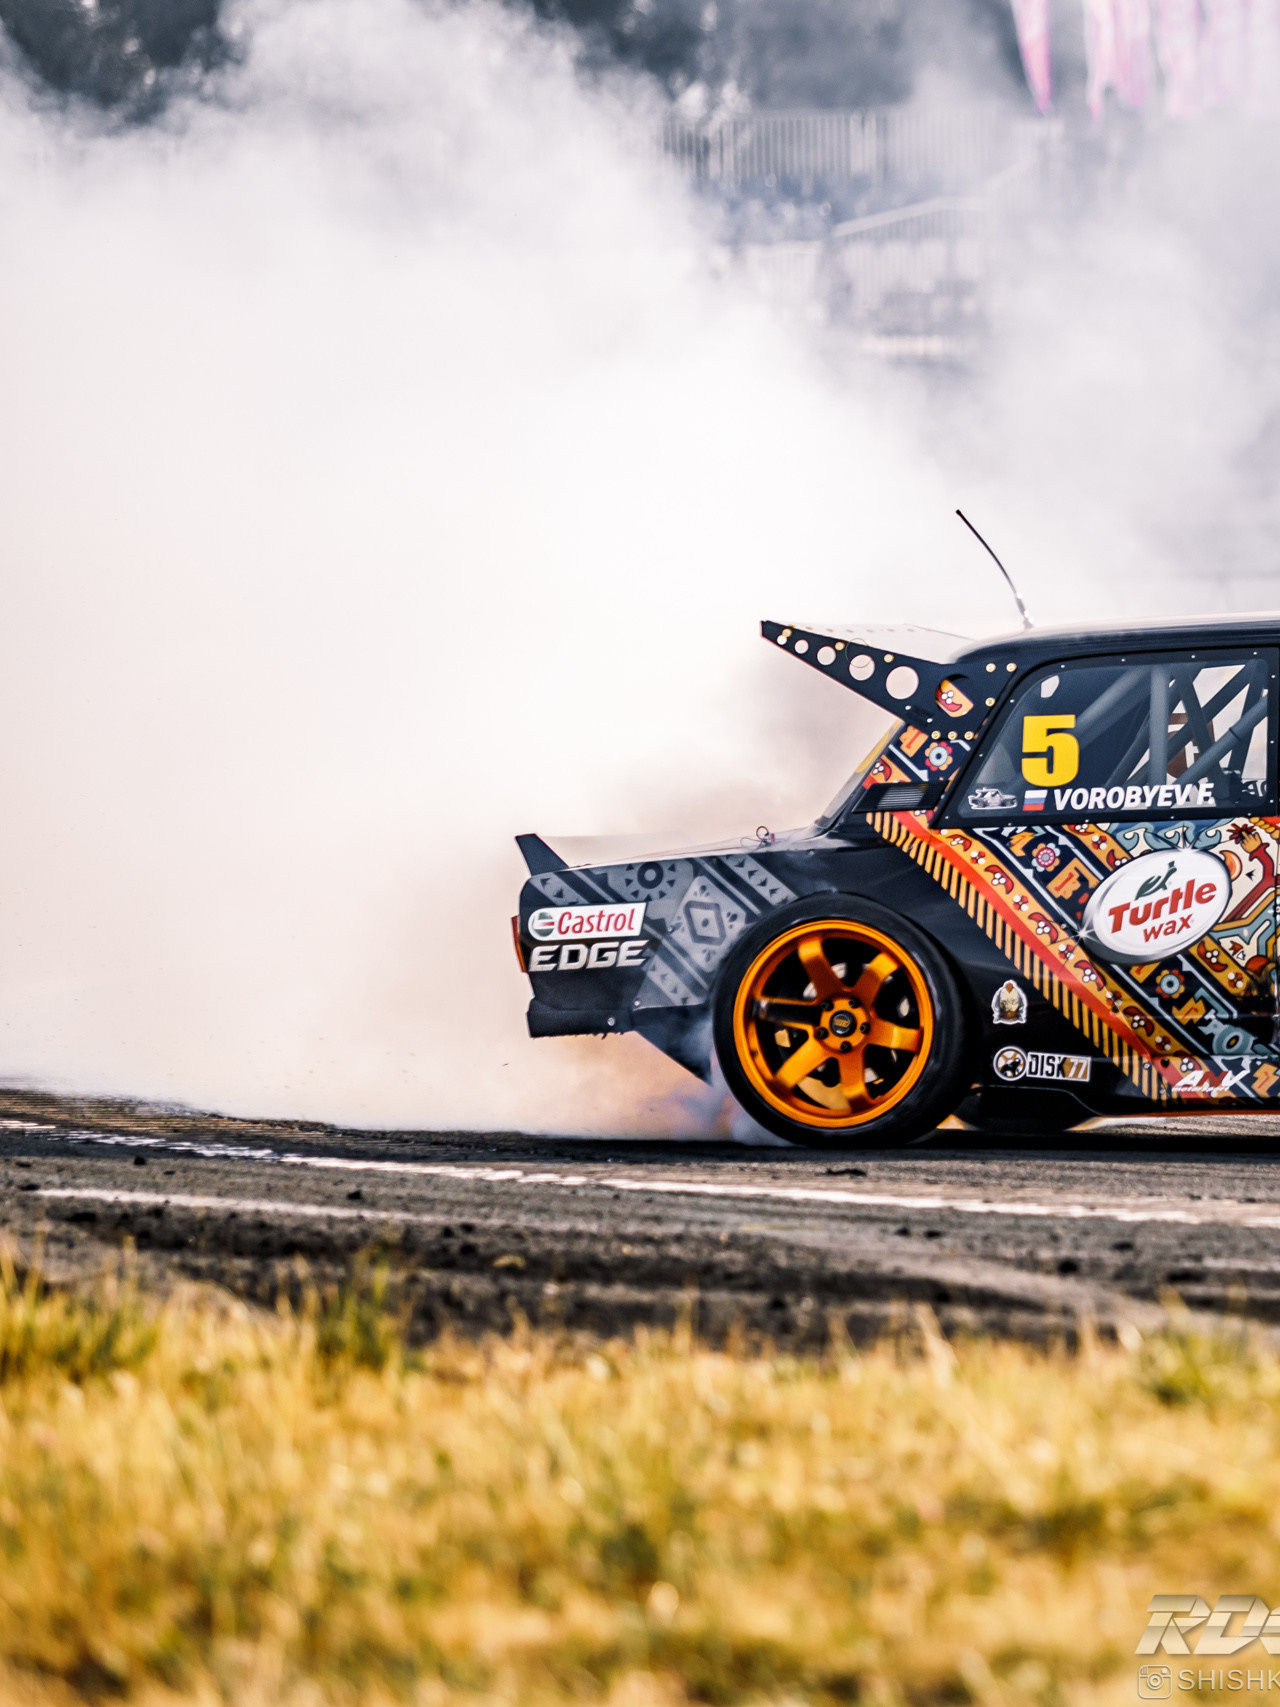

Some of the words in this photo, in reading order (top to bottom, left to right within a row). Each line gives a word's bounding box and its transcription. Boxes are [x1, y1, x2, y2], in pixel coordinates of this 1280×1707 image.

[1021, 714, 1080, 787] 5
[1053, 784, 1193, 811] VOROBYEV
[1197, 782, 1215, 806] F.
[1108, 878, 1218, 934] Turtle
[557, 908, 636, 936] Castrol
[1142, 913, 1193, 943] wax
[528, 939, 650, 972] EDGE
